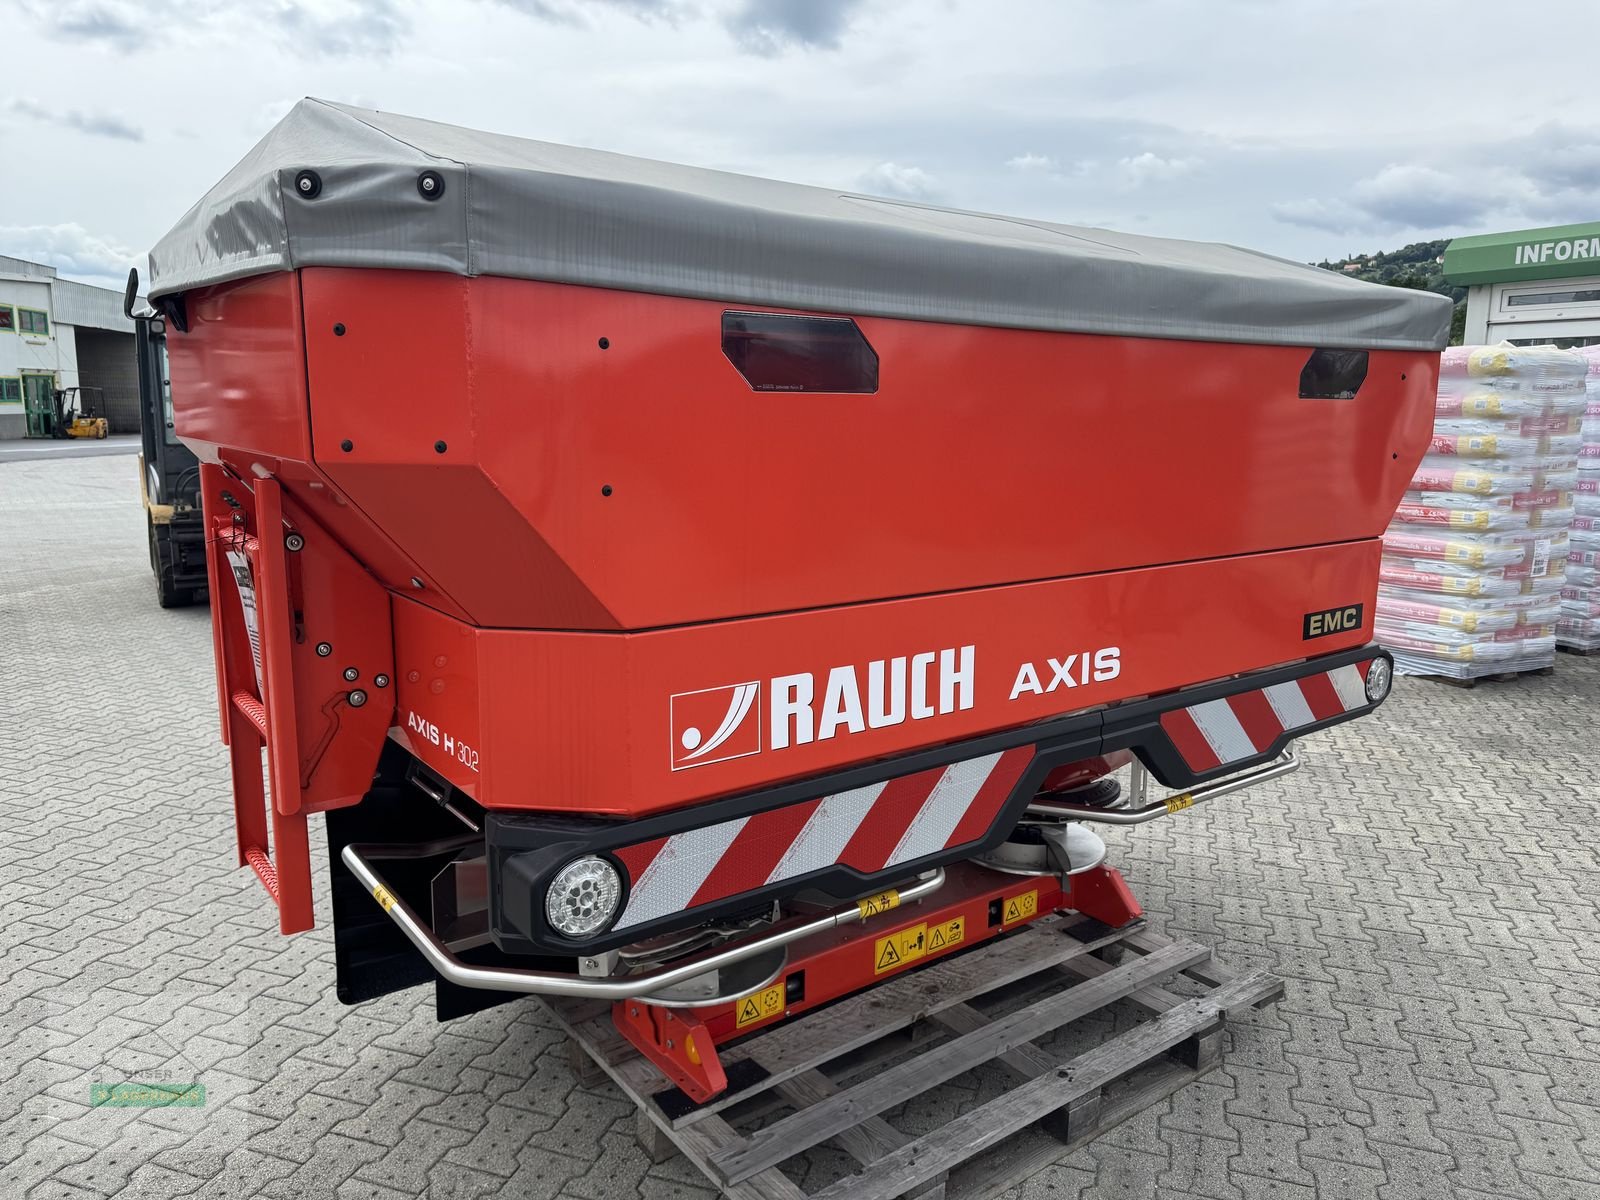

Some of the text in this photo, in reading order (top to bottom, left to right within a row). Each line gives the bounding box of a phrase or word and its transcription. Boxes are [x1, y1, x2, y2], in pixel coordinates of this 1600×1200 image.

[1309, 608, 1357, 636] EMC
[770, 644, 1121, 751] RAUCH AXIS
[408, 711, 440, 746] AXIS
[444, 732, 454, 756] H
